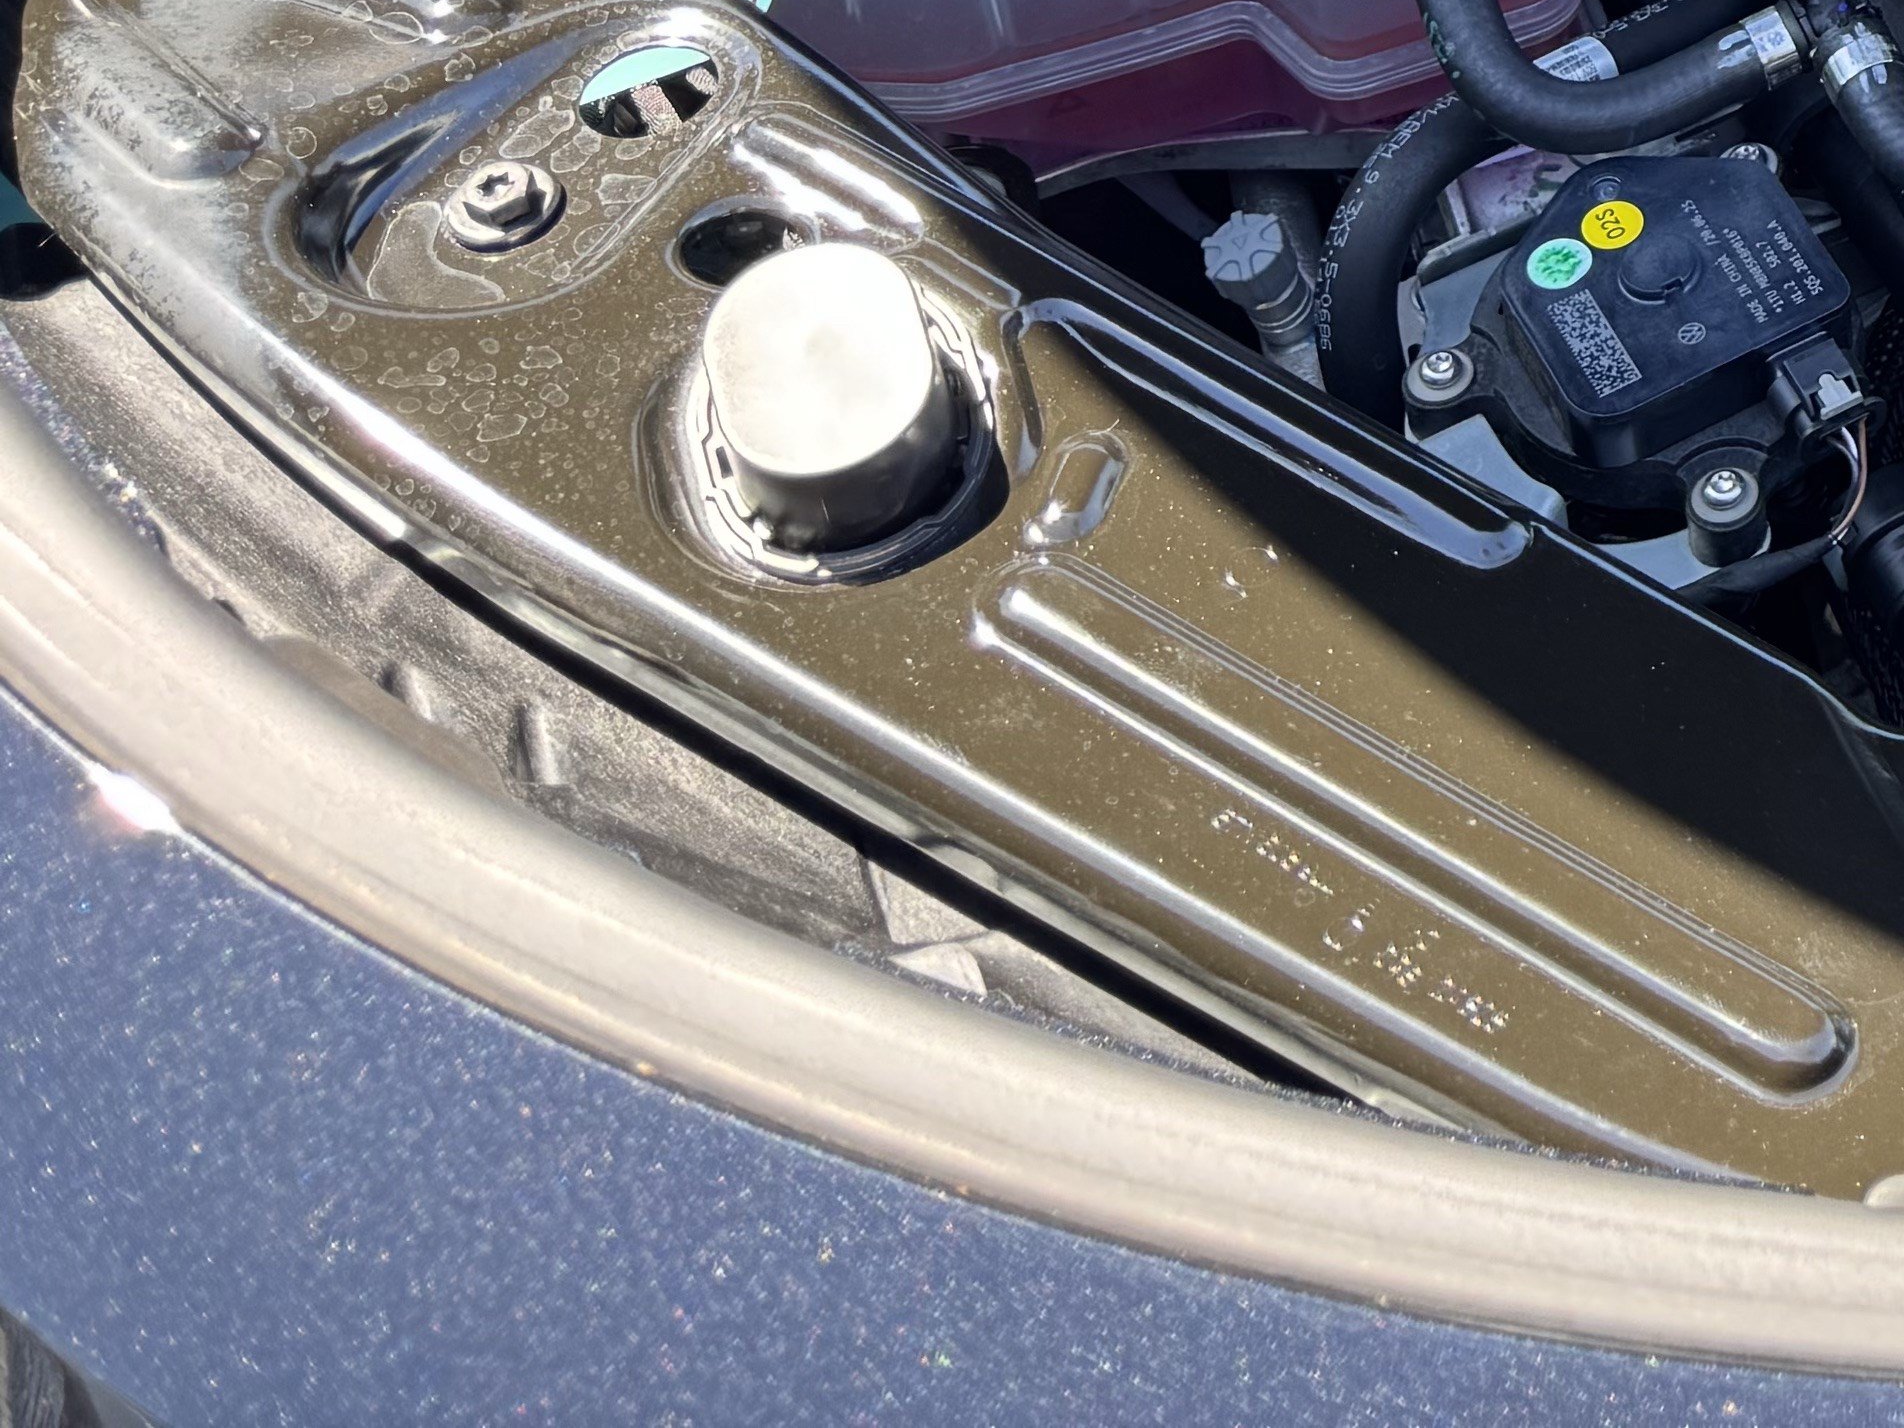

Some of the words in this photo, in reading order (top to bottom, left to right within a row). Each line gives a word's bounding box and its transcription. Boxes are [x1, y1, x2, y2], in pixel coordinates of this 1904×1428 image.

[1715, 251, 1742, 284] CHINA
[1736, 282, 1752, 298] IN
[1747, 298, 1769, 324] MADE
